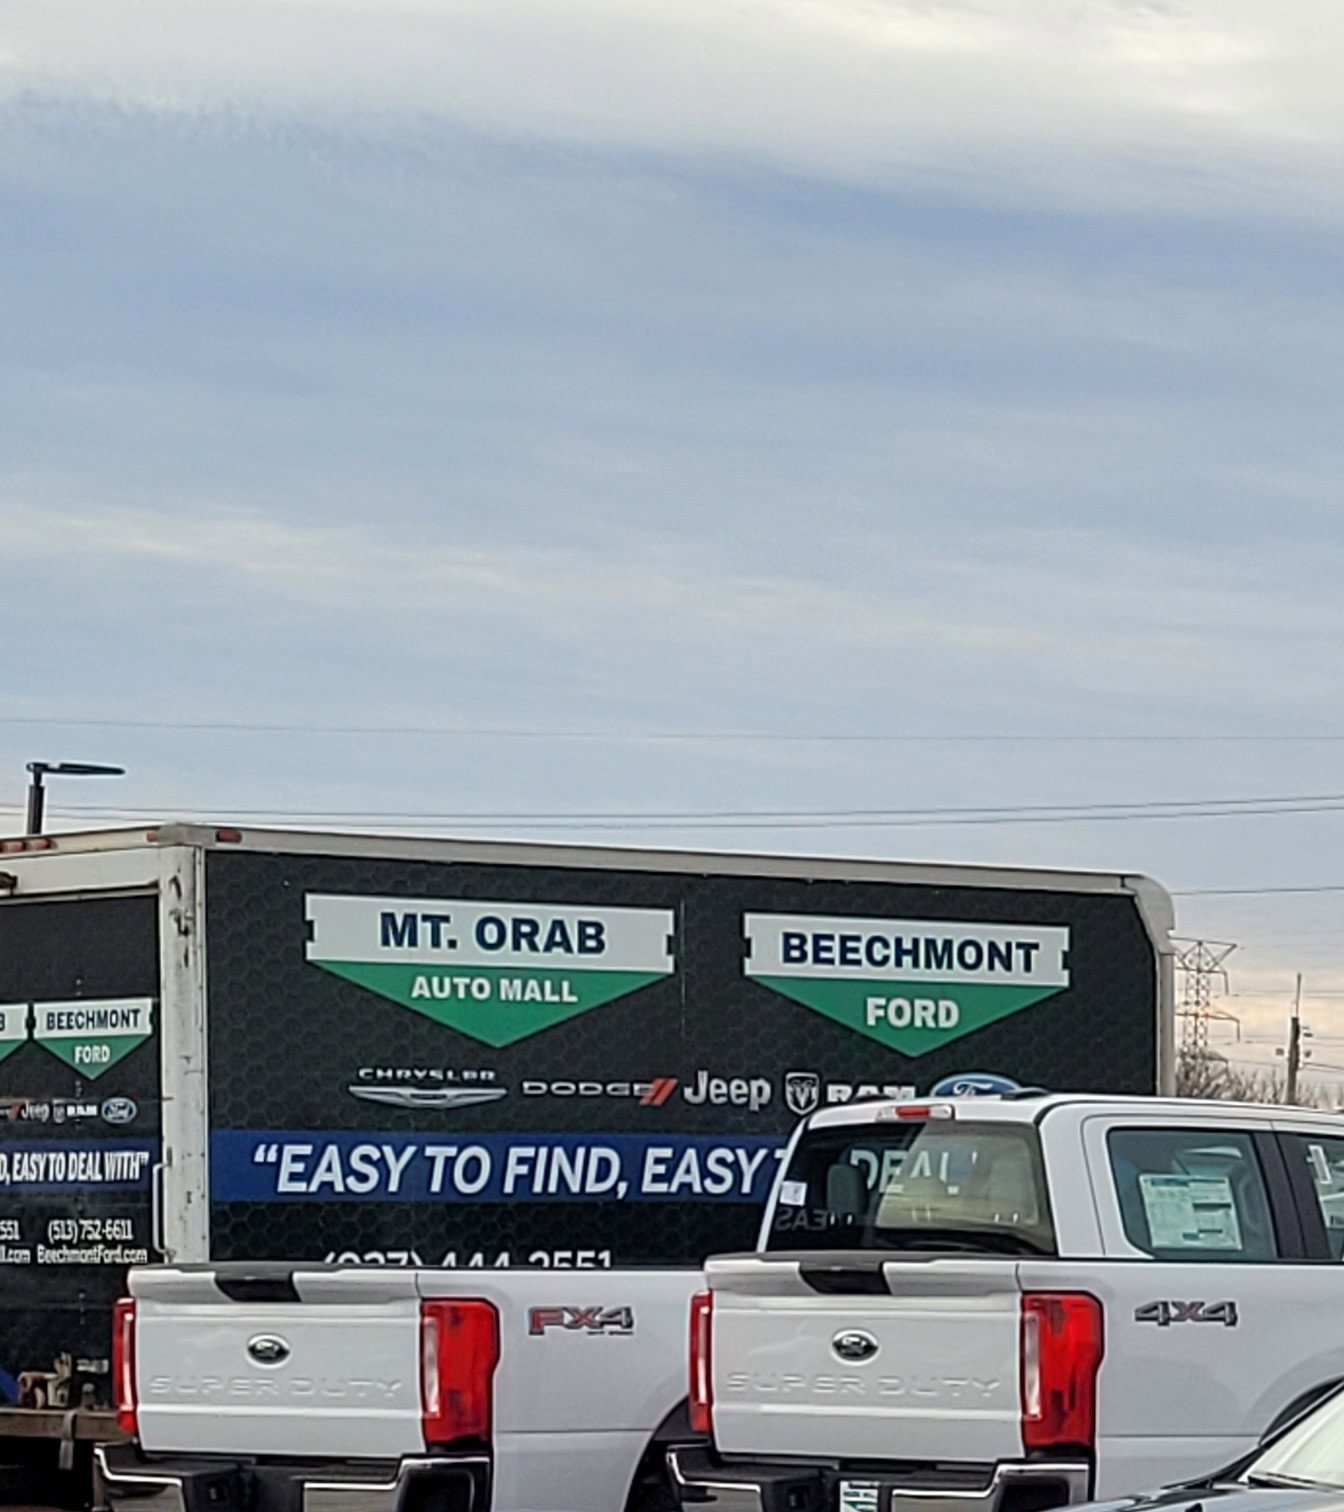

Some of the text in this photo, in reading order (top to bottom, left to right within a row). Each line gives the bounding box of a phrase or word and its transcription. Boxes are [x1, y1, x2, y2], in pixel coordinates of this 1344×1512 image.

[380, 911, 607, 955] MT. ORAB
[782, 931, 1040, 974] BEECHMONT
[411, 976, 579, 1003] AUTO MALL
[46, 1007, 141, 1031] BEECHMONT
[866, 996, 960, 1029] FORD
[74, 1044, 111, 1065] FORD
[358, 1067, 497, 1082] CHRYSLER
[522, 1081, 656, 1097] DODGE
[684, 1070, 771, 1112] Jeep
[12, 1152, 47, 1182] EASY
[48, 1152, 67, 1182] TO
[67, 1152, 102, 1182] DEAL
[424, 1146, 492, 1195] TO
[503, 1147, 629, 1200] FIND,
[641, 1147, 768, 1194] EASY
[48, 1219, 78, 1245] (513)
[528, 1306, 634, 1336] FX4
